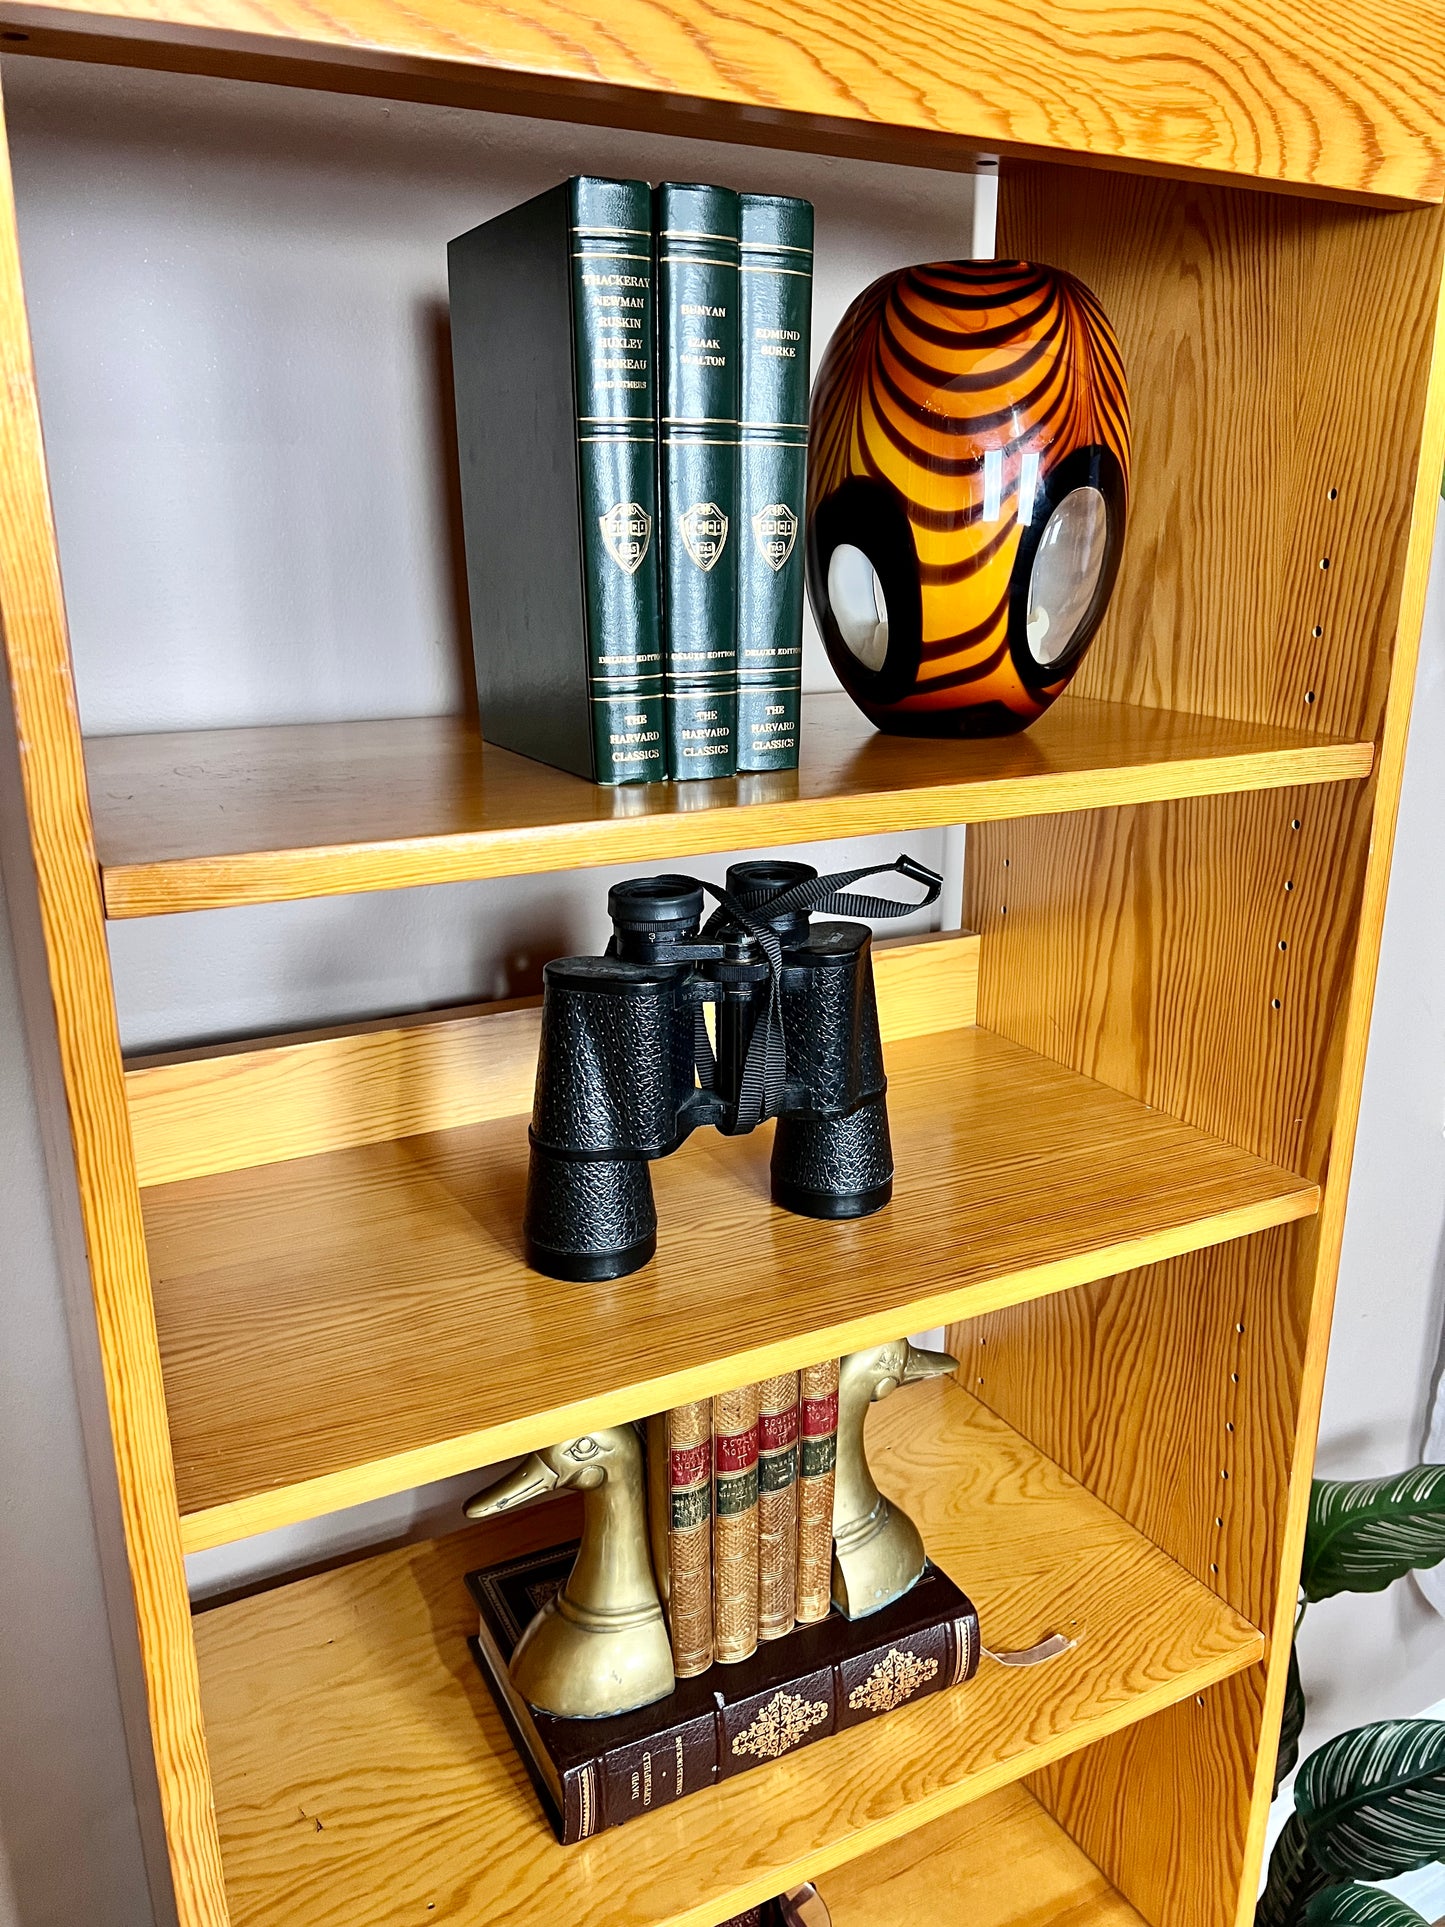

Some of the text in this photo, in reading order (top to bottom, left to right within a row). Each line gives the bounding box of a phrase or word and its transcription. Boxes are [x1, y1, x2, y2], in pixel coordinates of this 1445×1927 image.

[582, 274, 650, 288] THACKERAY
[594, 295, 644, 308] NEWMAN
[681, 304, 726, 317] BUNYAN
[598, 316, 641, 328] RUSKIN
[755, 328, 800, 341] EDMUND
[599, 337, 643, 349] HUXLEY
[761, 345, 796, 358] BURKE
[593, 358, 647, 370] THOREAU
[680, 354, 725, 366] WALTON
[615, 380, 647, 389] OTHERS
[695, 710, 718, 720] THE
[765, 705, 785, 715] THE
[624, 714, 648, 725] THE
[682, 727, 730, 739] HARVARD
[751, 722, 795, 733] HARVARD
[609, 731, 660, 745] HARVARD
[683, 744, 729, 757] CLASSICS
[752, 738, 794, 751] CLASSICS
[612, 749, 660, 762] CLASSICS
[643, 1752, 651, 1805] COPPERFIELD
